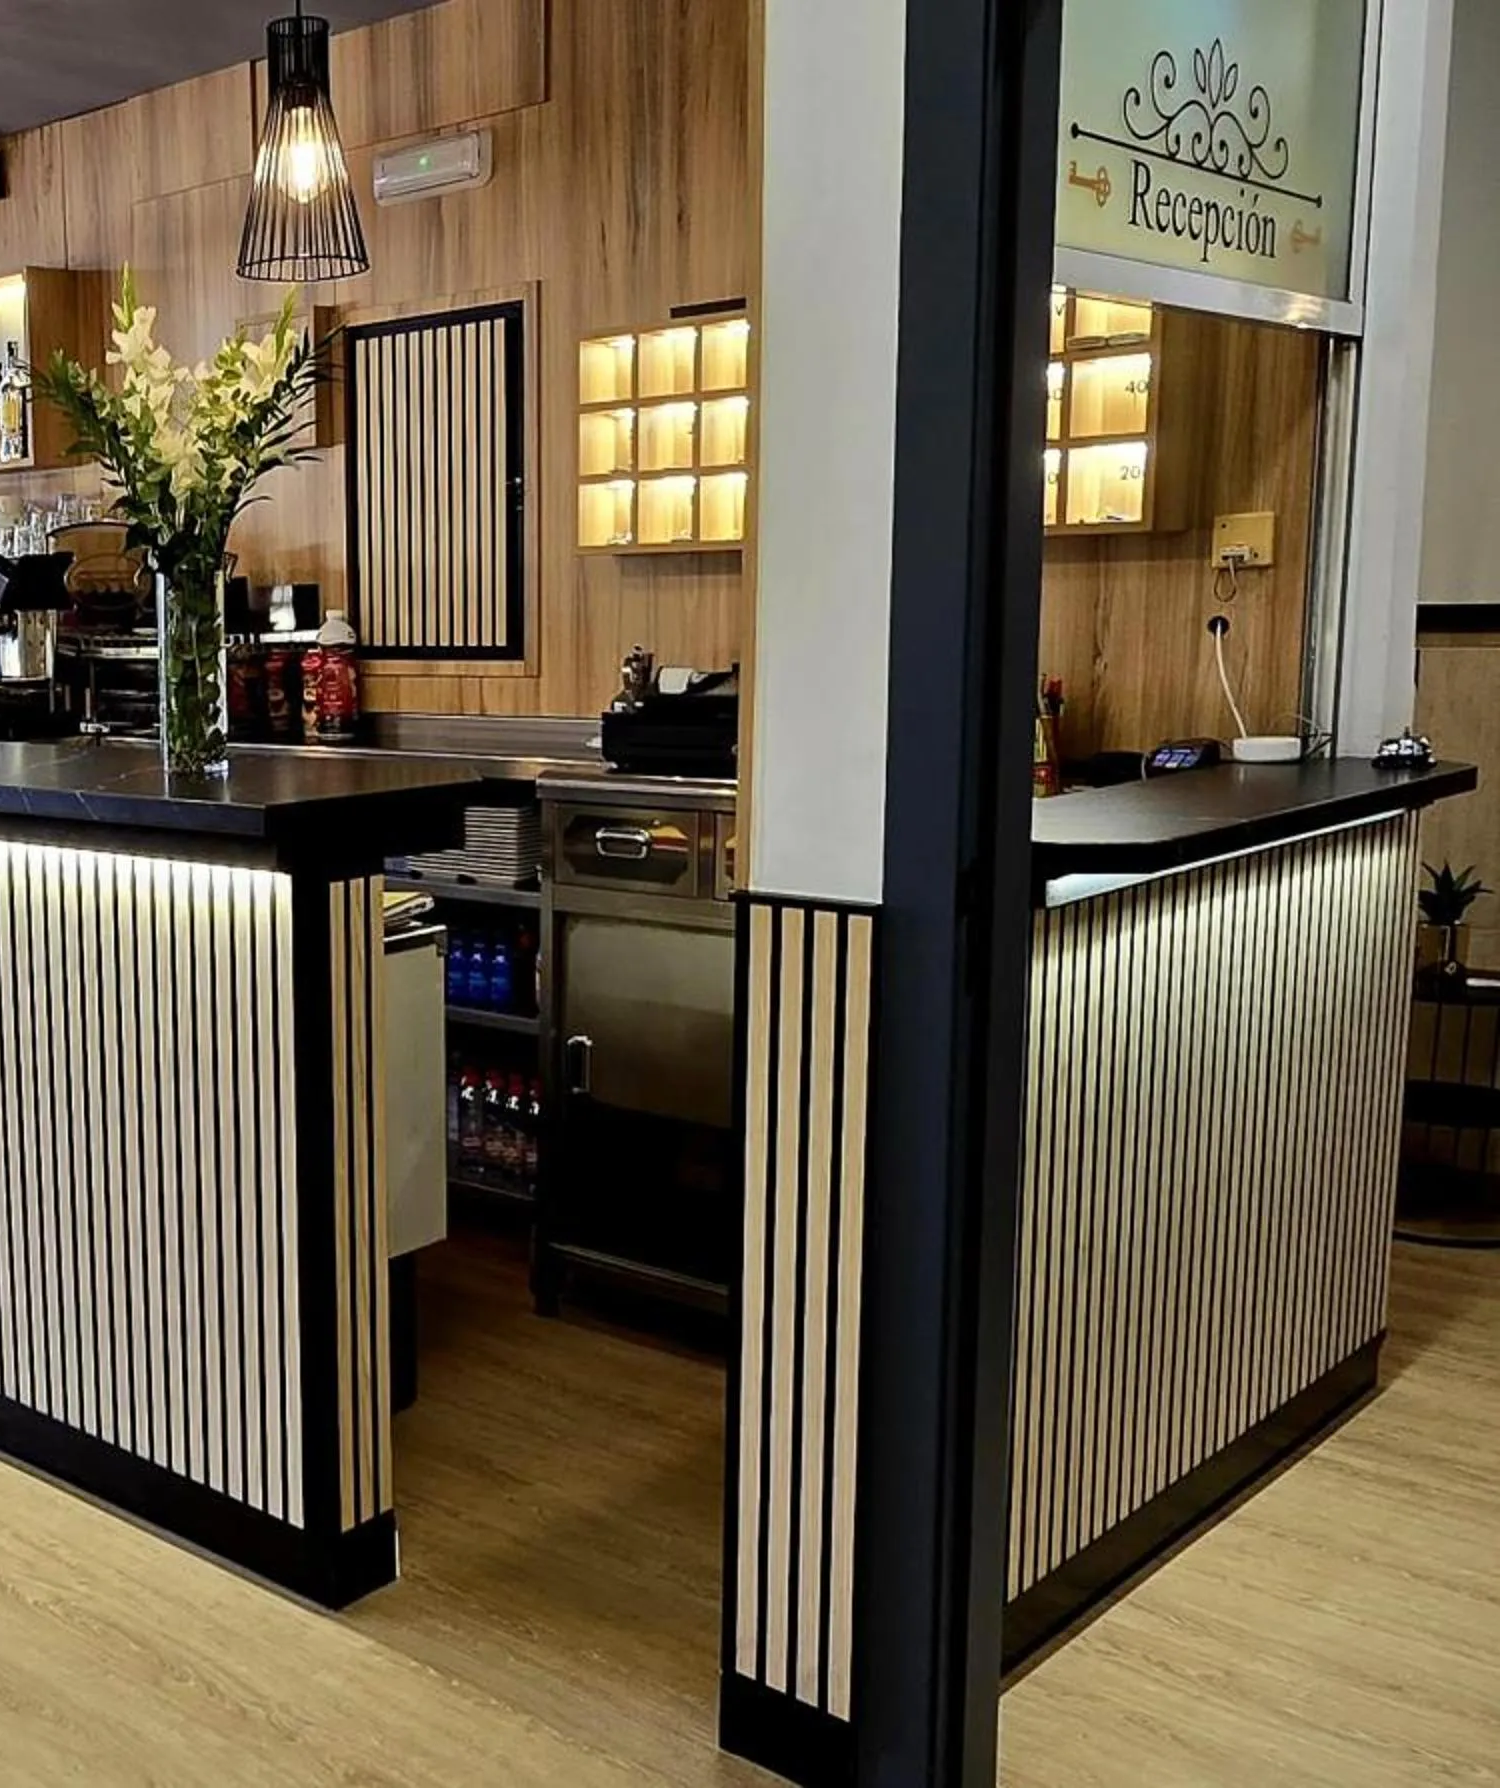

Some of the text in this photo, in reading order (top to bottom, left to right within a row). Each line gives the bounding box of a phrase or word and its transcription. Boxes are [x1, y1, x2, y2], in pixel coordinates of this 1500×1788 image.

[1128, 158, 1278, 263] Recepción
[1124, 379, 1150, 394] 40
[1119, 465, 1141, 481] 20
